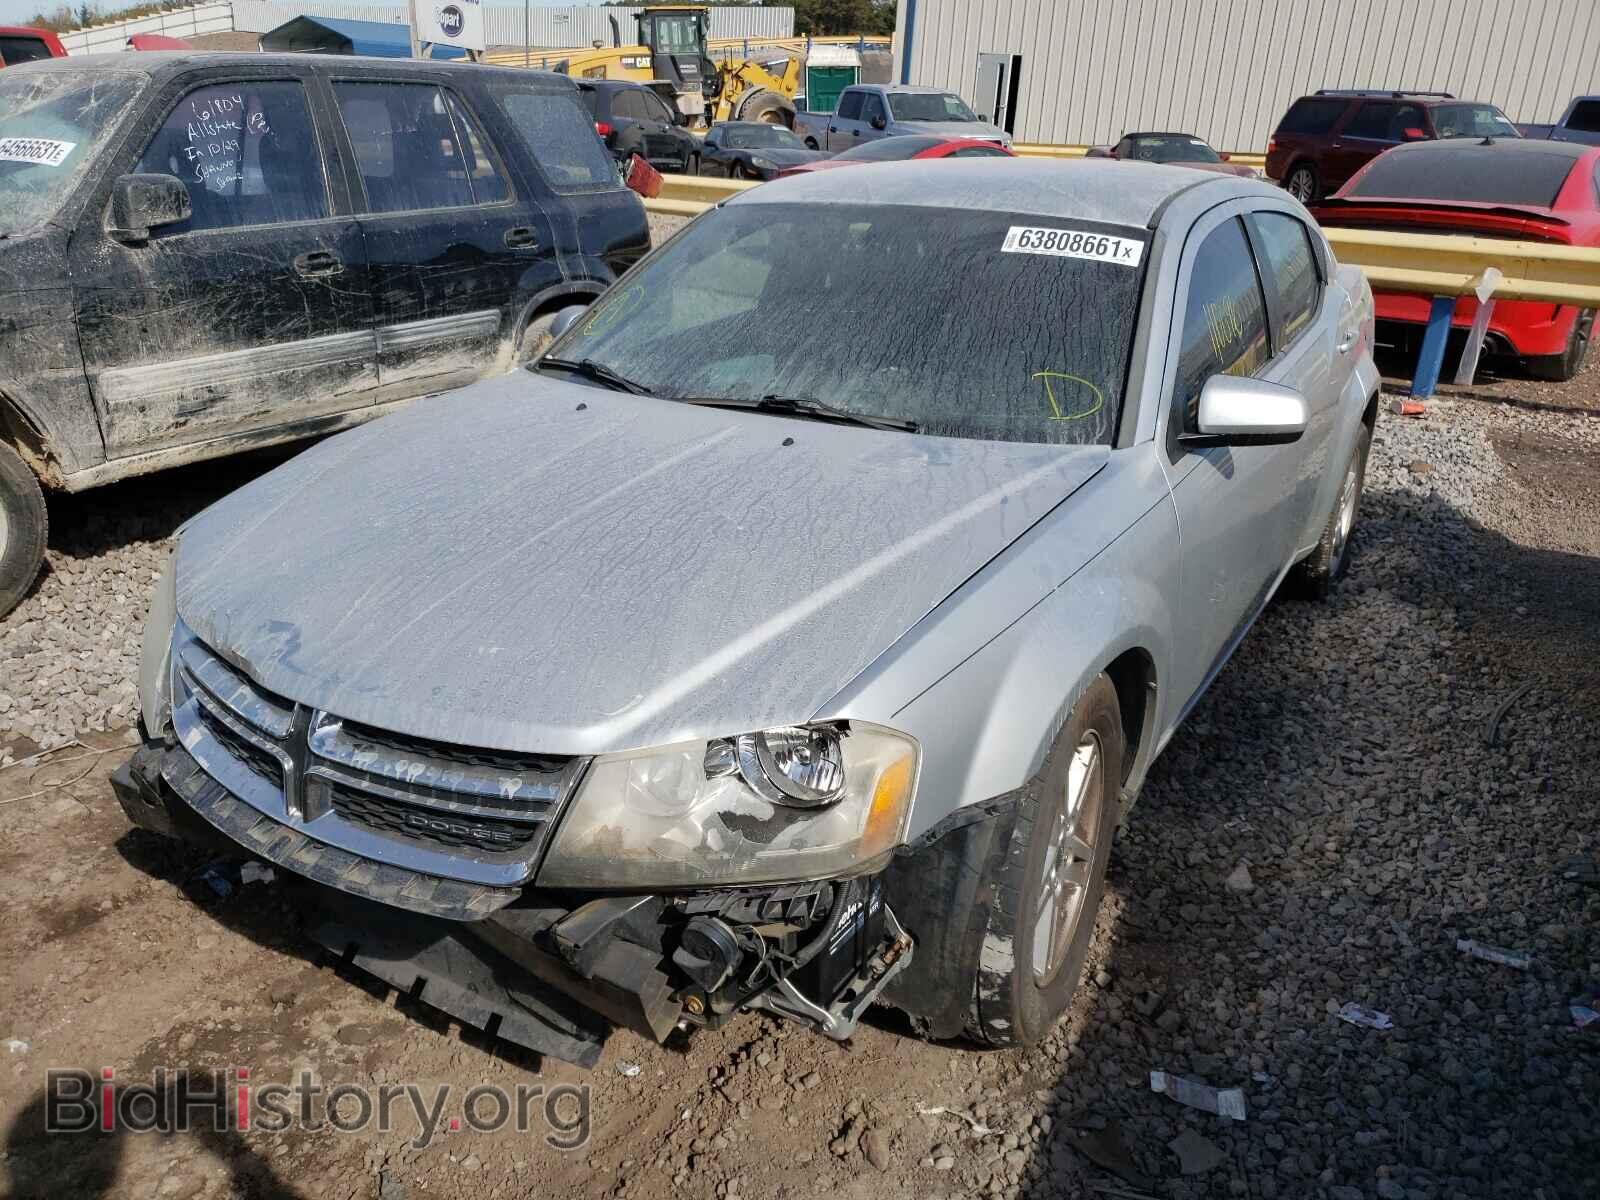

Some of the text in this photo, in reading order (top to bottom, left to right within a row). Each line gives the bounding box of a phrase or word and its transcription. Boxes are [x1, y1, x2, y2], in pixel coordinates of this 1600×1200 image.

[636, 57, 651, 68] CAT
[187, 120, 242, 142] Allstate
[1031, 366, 1103, 421] D
[408, 815, 512, 841] DODGE
